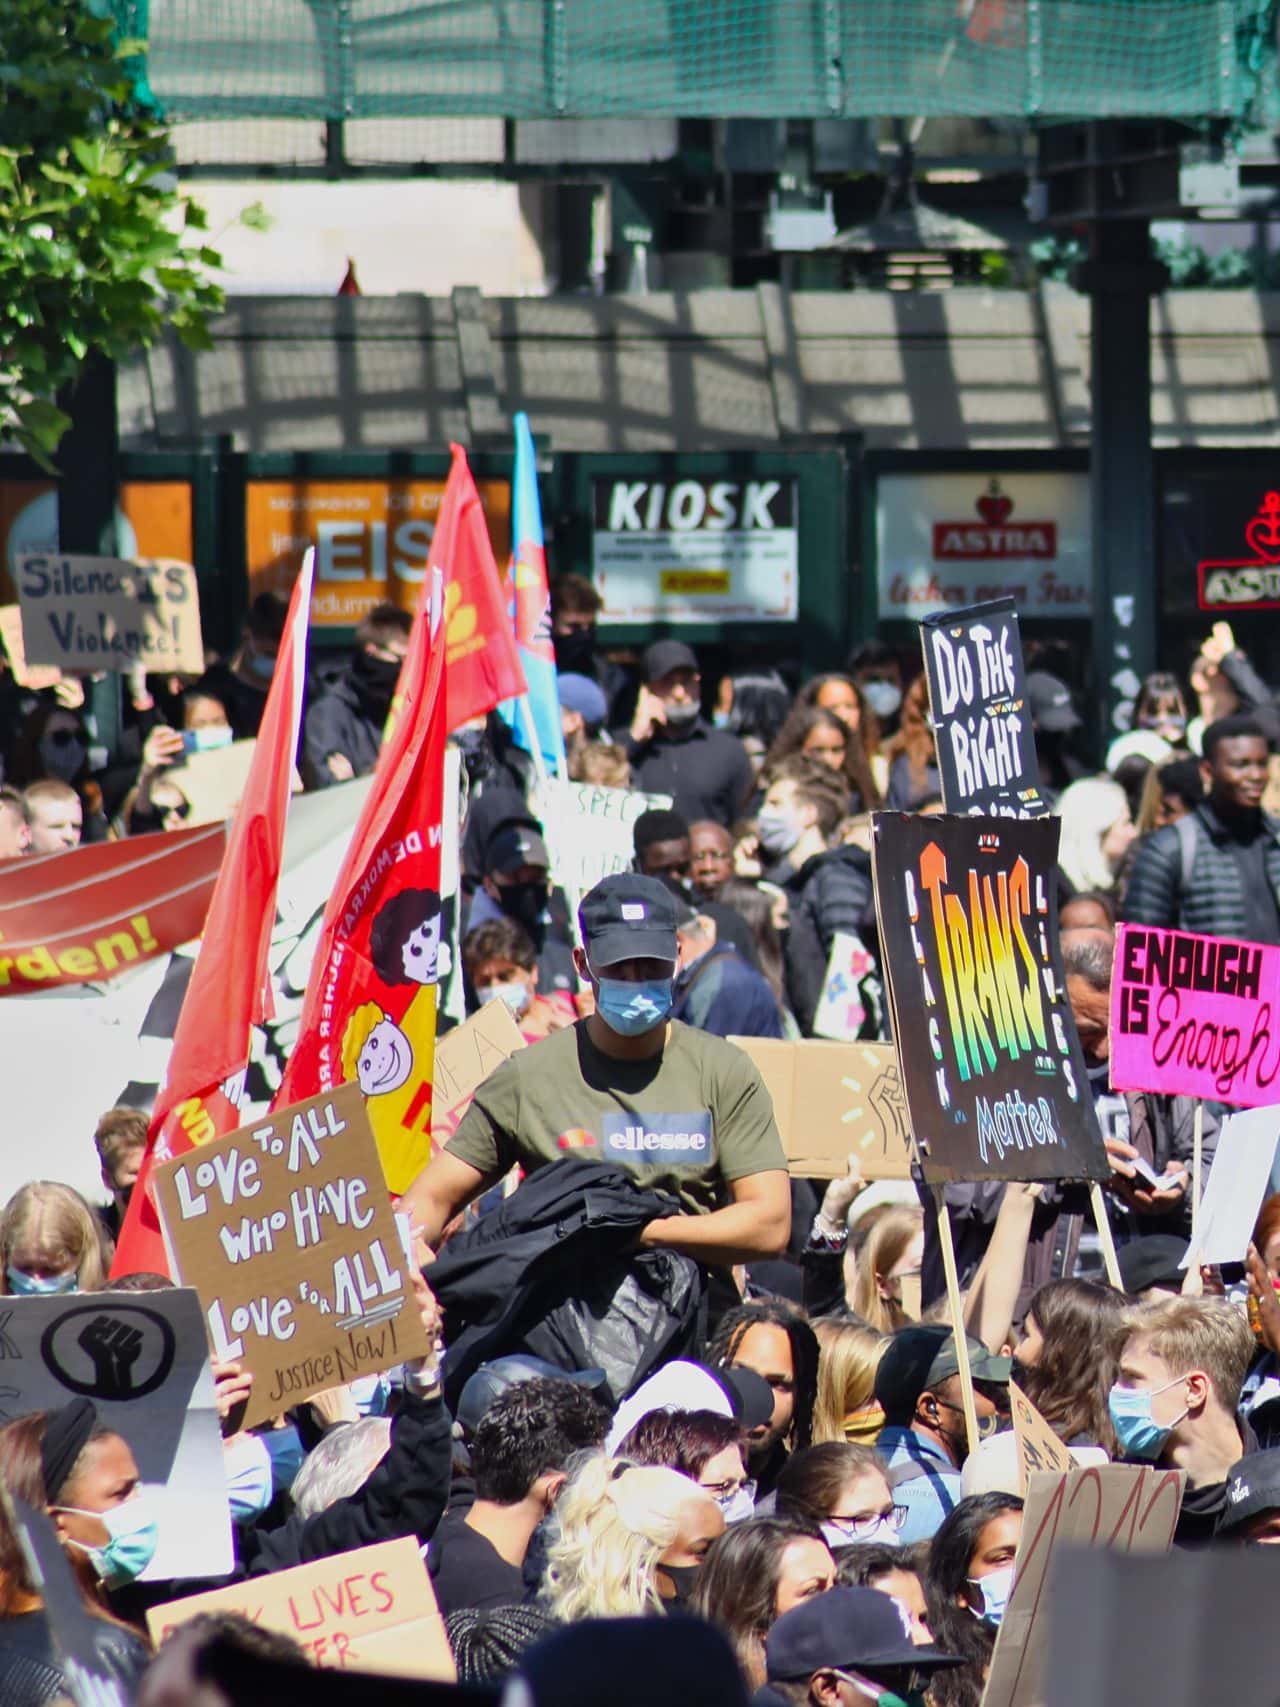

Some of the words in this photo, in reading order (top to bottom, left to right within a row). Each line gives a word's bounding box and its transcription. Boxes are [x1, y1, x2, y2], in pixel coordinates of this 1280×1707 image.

[609, 481, 779, 532] KIOSK
[316, 517, 440, 583] EIS
[942, 529, 1048, 554] ASTRA
[969, 623, 1015, 700] THE
[904, 869, 951, 1111] BLACK
[919, 840, 1048, 1082] TRANS
[1123, 930, 1264, 1001] ENOUGH
[1119, 986, 1150, 1035] IS
[287, 1102, 346, 1173] ALL
[608, 1126, 707, 1152] ellesse
[219, 1210, 287, 1265] WHO
[332, 1238, 402, 1315] ALL
[288, 1570, 394, 1632] LIVES
